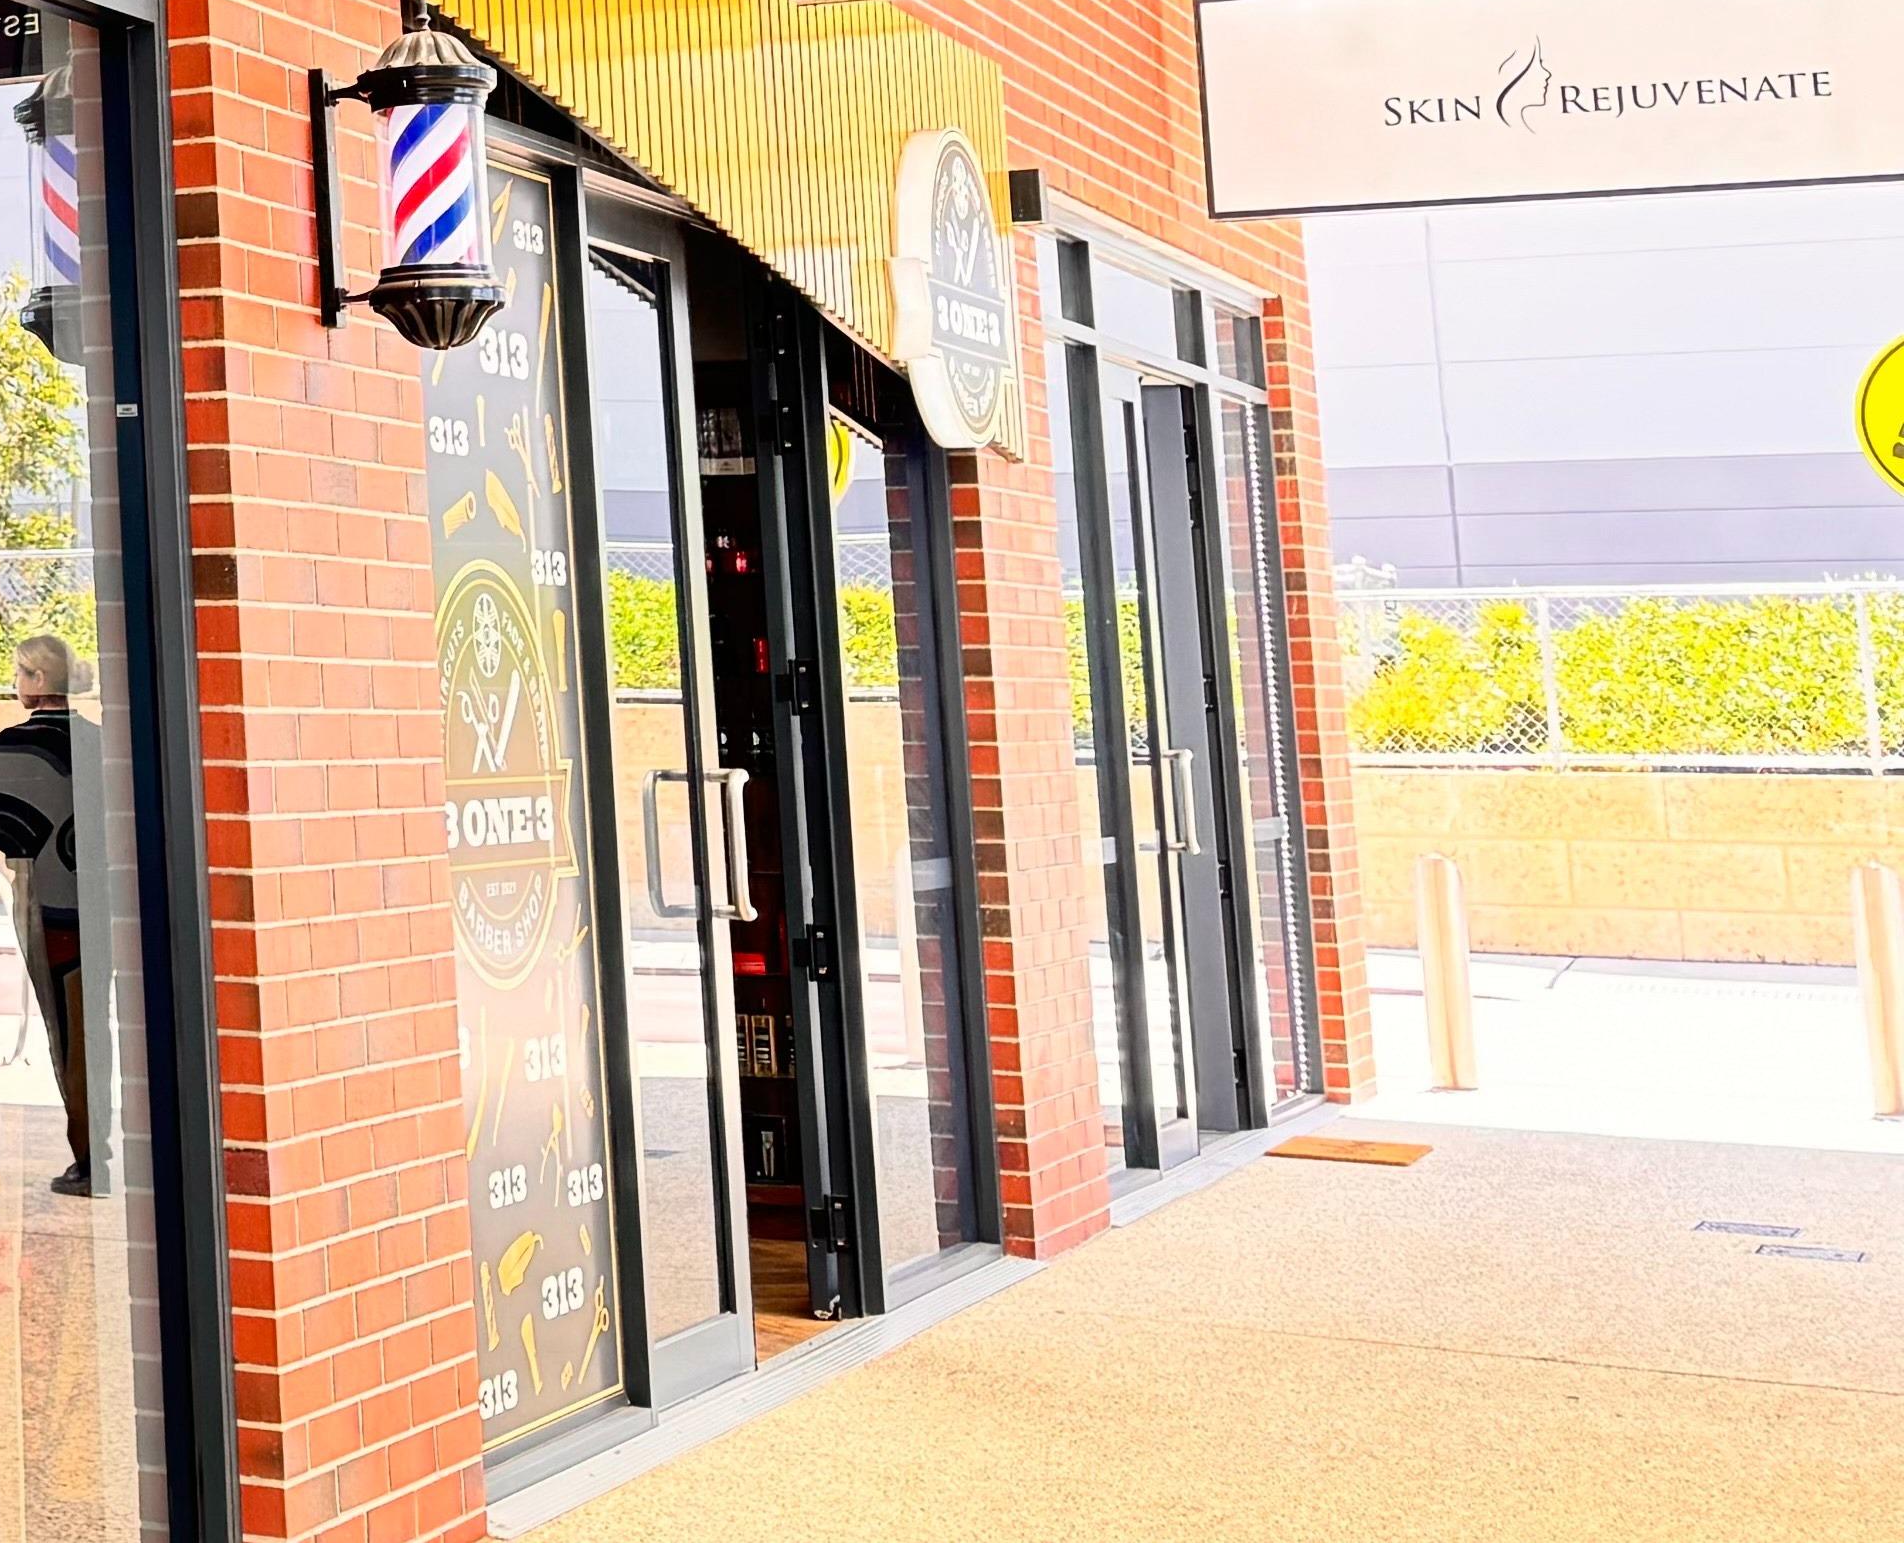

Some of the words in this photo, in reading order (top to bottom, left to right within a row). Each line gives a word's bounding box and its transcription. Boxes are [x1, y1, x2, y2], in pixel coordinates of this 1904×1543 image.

[1383, 92, 1482, 129] SKIN
[1558, 68, 1832, 118] REJUVENATE
[513, 218, 544, 255] 313
[478, 326, 529, 380] 313
[428, 416, 469, 456] 313
[530, 550, 567, 587] 313
[463, 797, 534, 847] ONE
[536, 796, 554, 841] 3
[459, 880, 512, 955] BARBER
[515, 873, 542, 947] SHOP
[524, 1034, 566, 1082] 313
[488, 1164, 528, 1210] 313
[567, 1163, 603, 1209] 313
[541, 1266, 584, 1320] 313
[478, 1368, 518, 1420] 313
